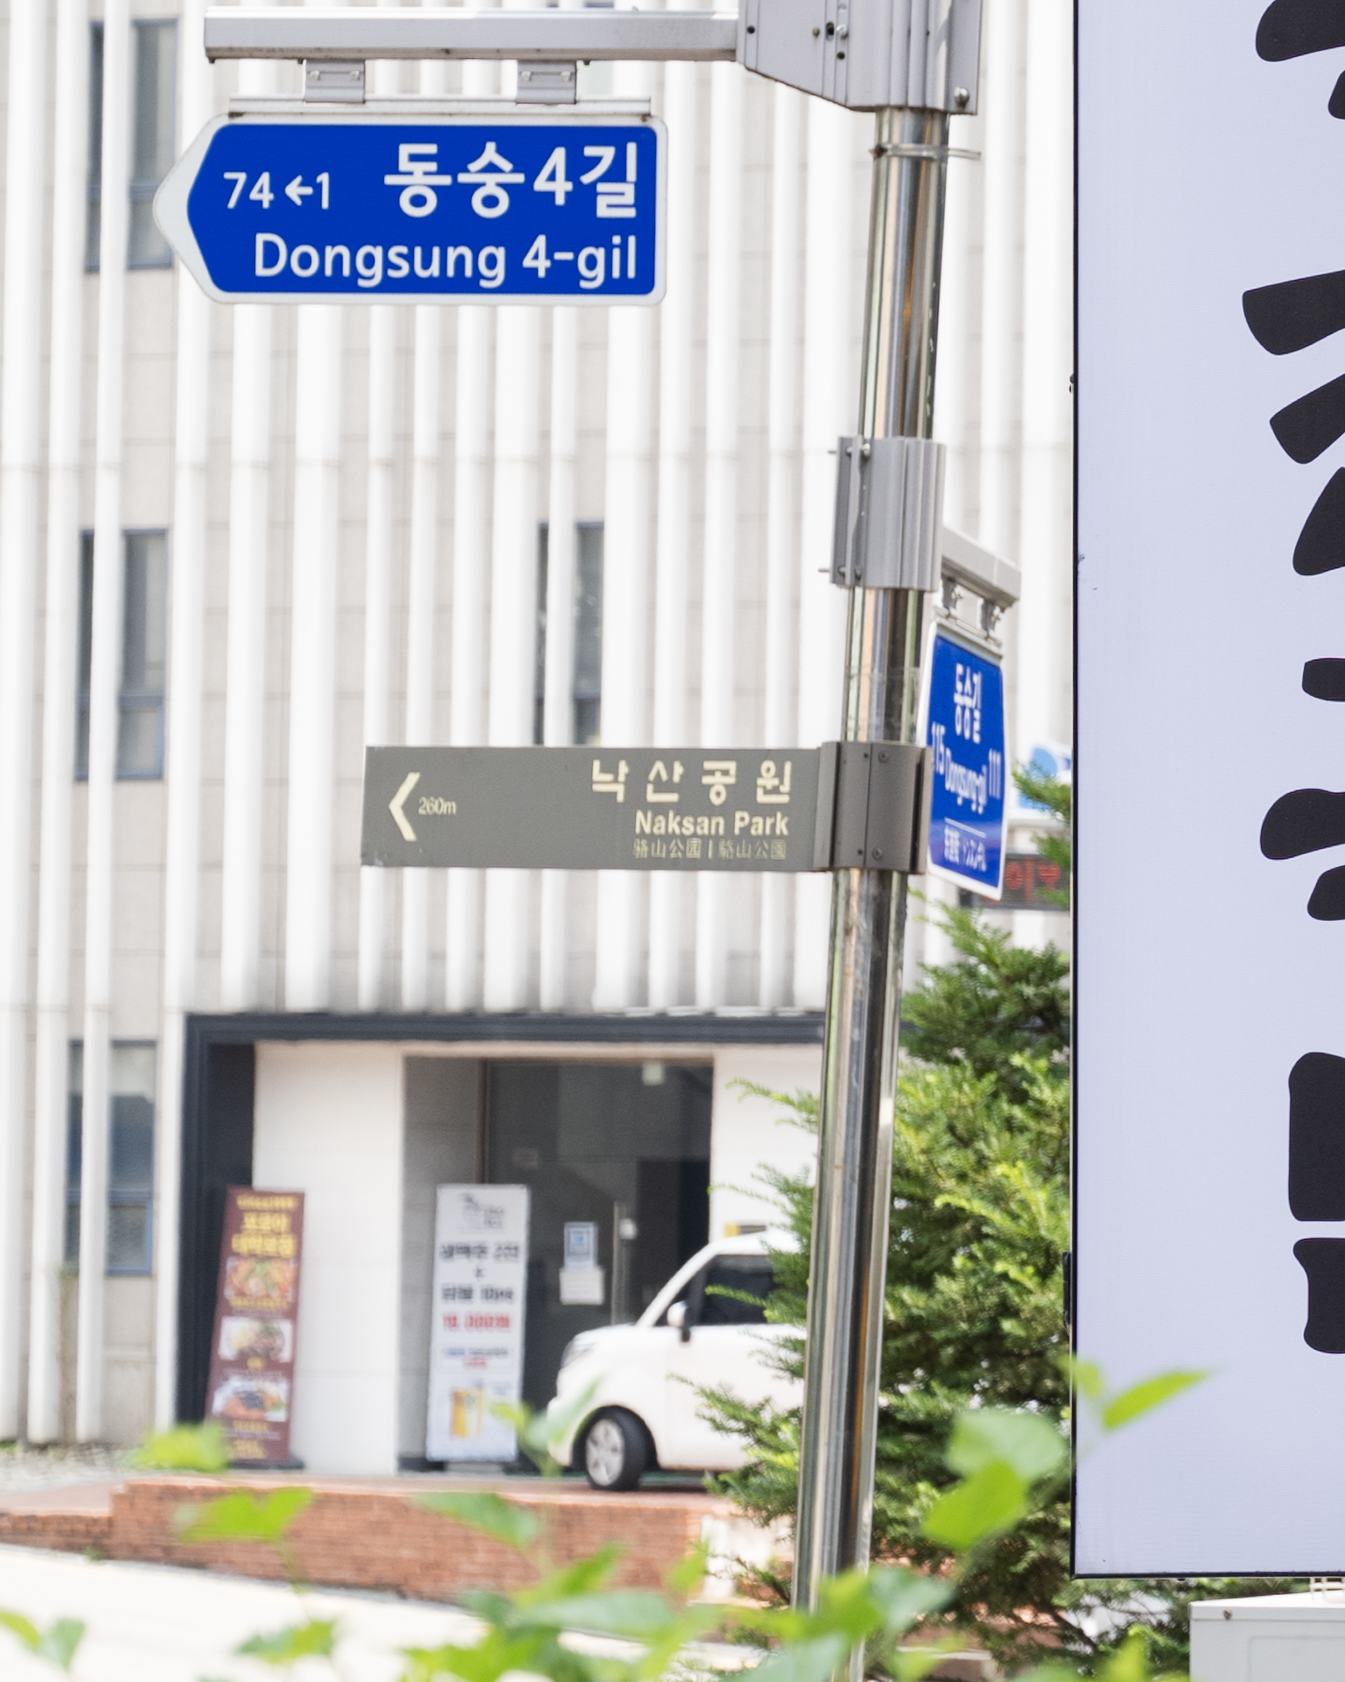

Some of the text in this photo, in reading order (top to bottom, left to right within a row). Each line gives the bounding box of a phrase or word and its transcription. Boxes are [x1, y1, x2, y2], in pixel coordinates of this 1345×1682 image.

[223, 141, 638, 219] 74 1 동숭4길
[254, 232, 637, 290] Dongsung 4-gil
[953, 662, 982, 745] 동숭길
[418, 796, 457, 815] 260m
[592, 759, 792, 806] 낙산공원
[945, 747, 987, 814] Dongsung-gil
[988, 748, 1001, 800] 111
[635, 809, 789, 836] Naksan Park
